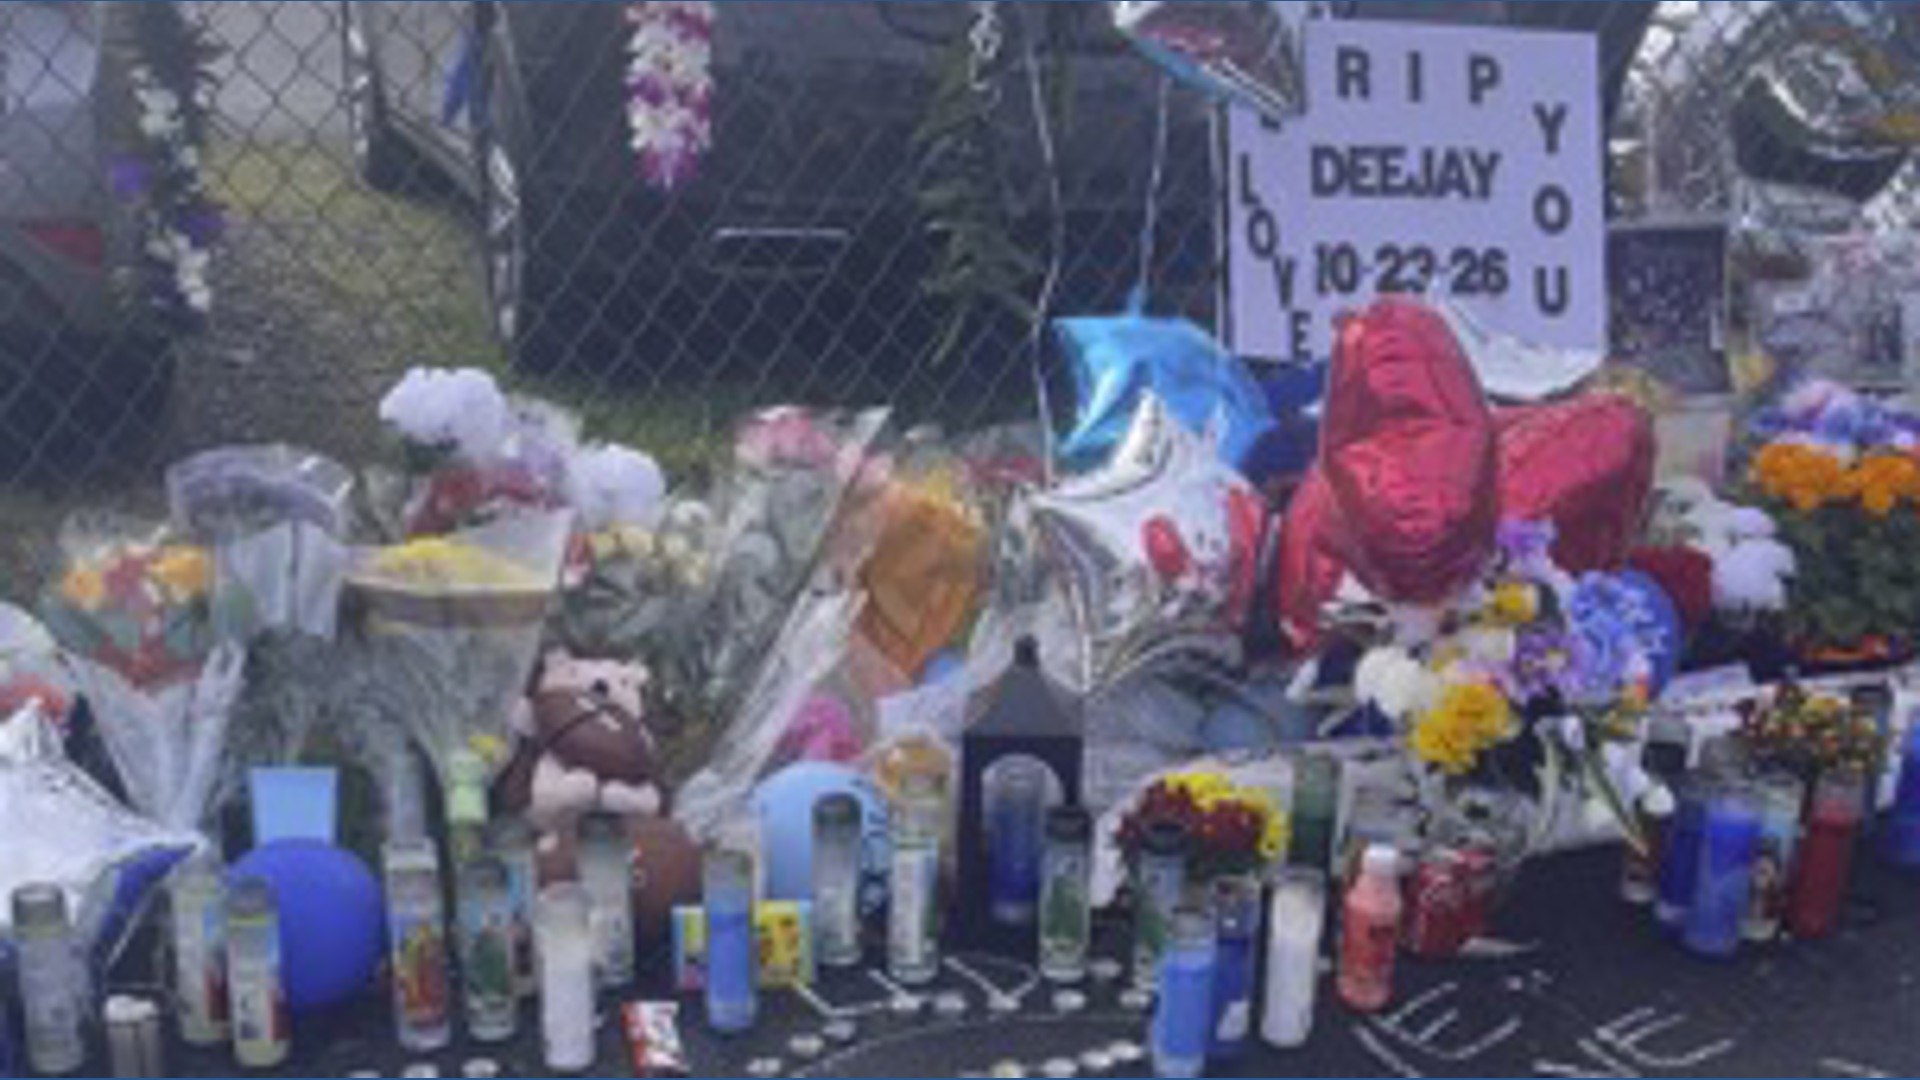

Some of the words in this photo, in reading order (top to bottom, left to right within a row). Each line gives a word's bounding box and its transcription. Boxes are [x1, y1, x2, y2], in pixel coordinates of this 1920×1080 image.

[1310, 145, 1502, 200] DEEJAY
[1533, 103, 1572, 317] YOU
[1238, 152, 1315, 362] LOVE
[1313, 242, 1510, 297] 10-23-26
